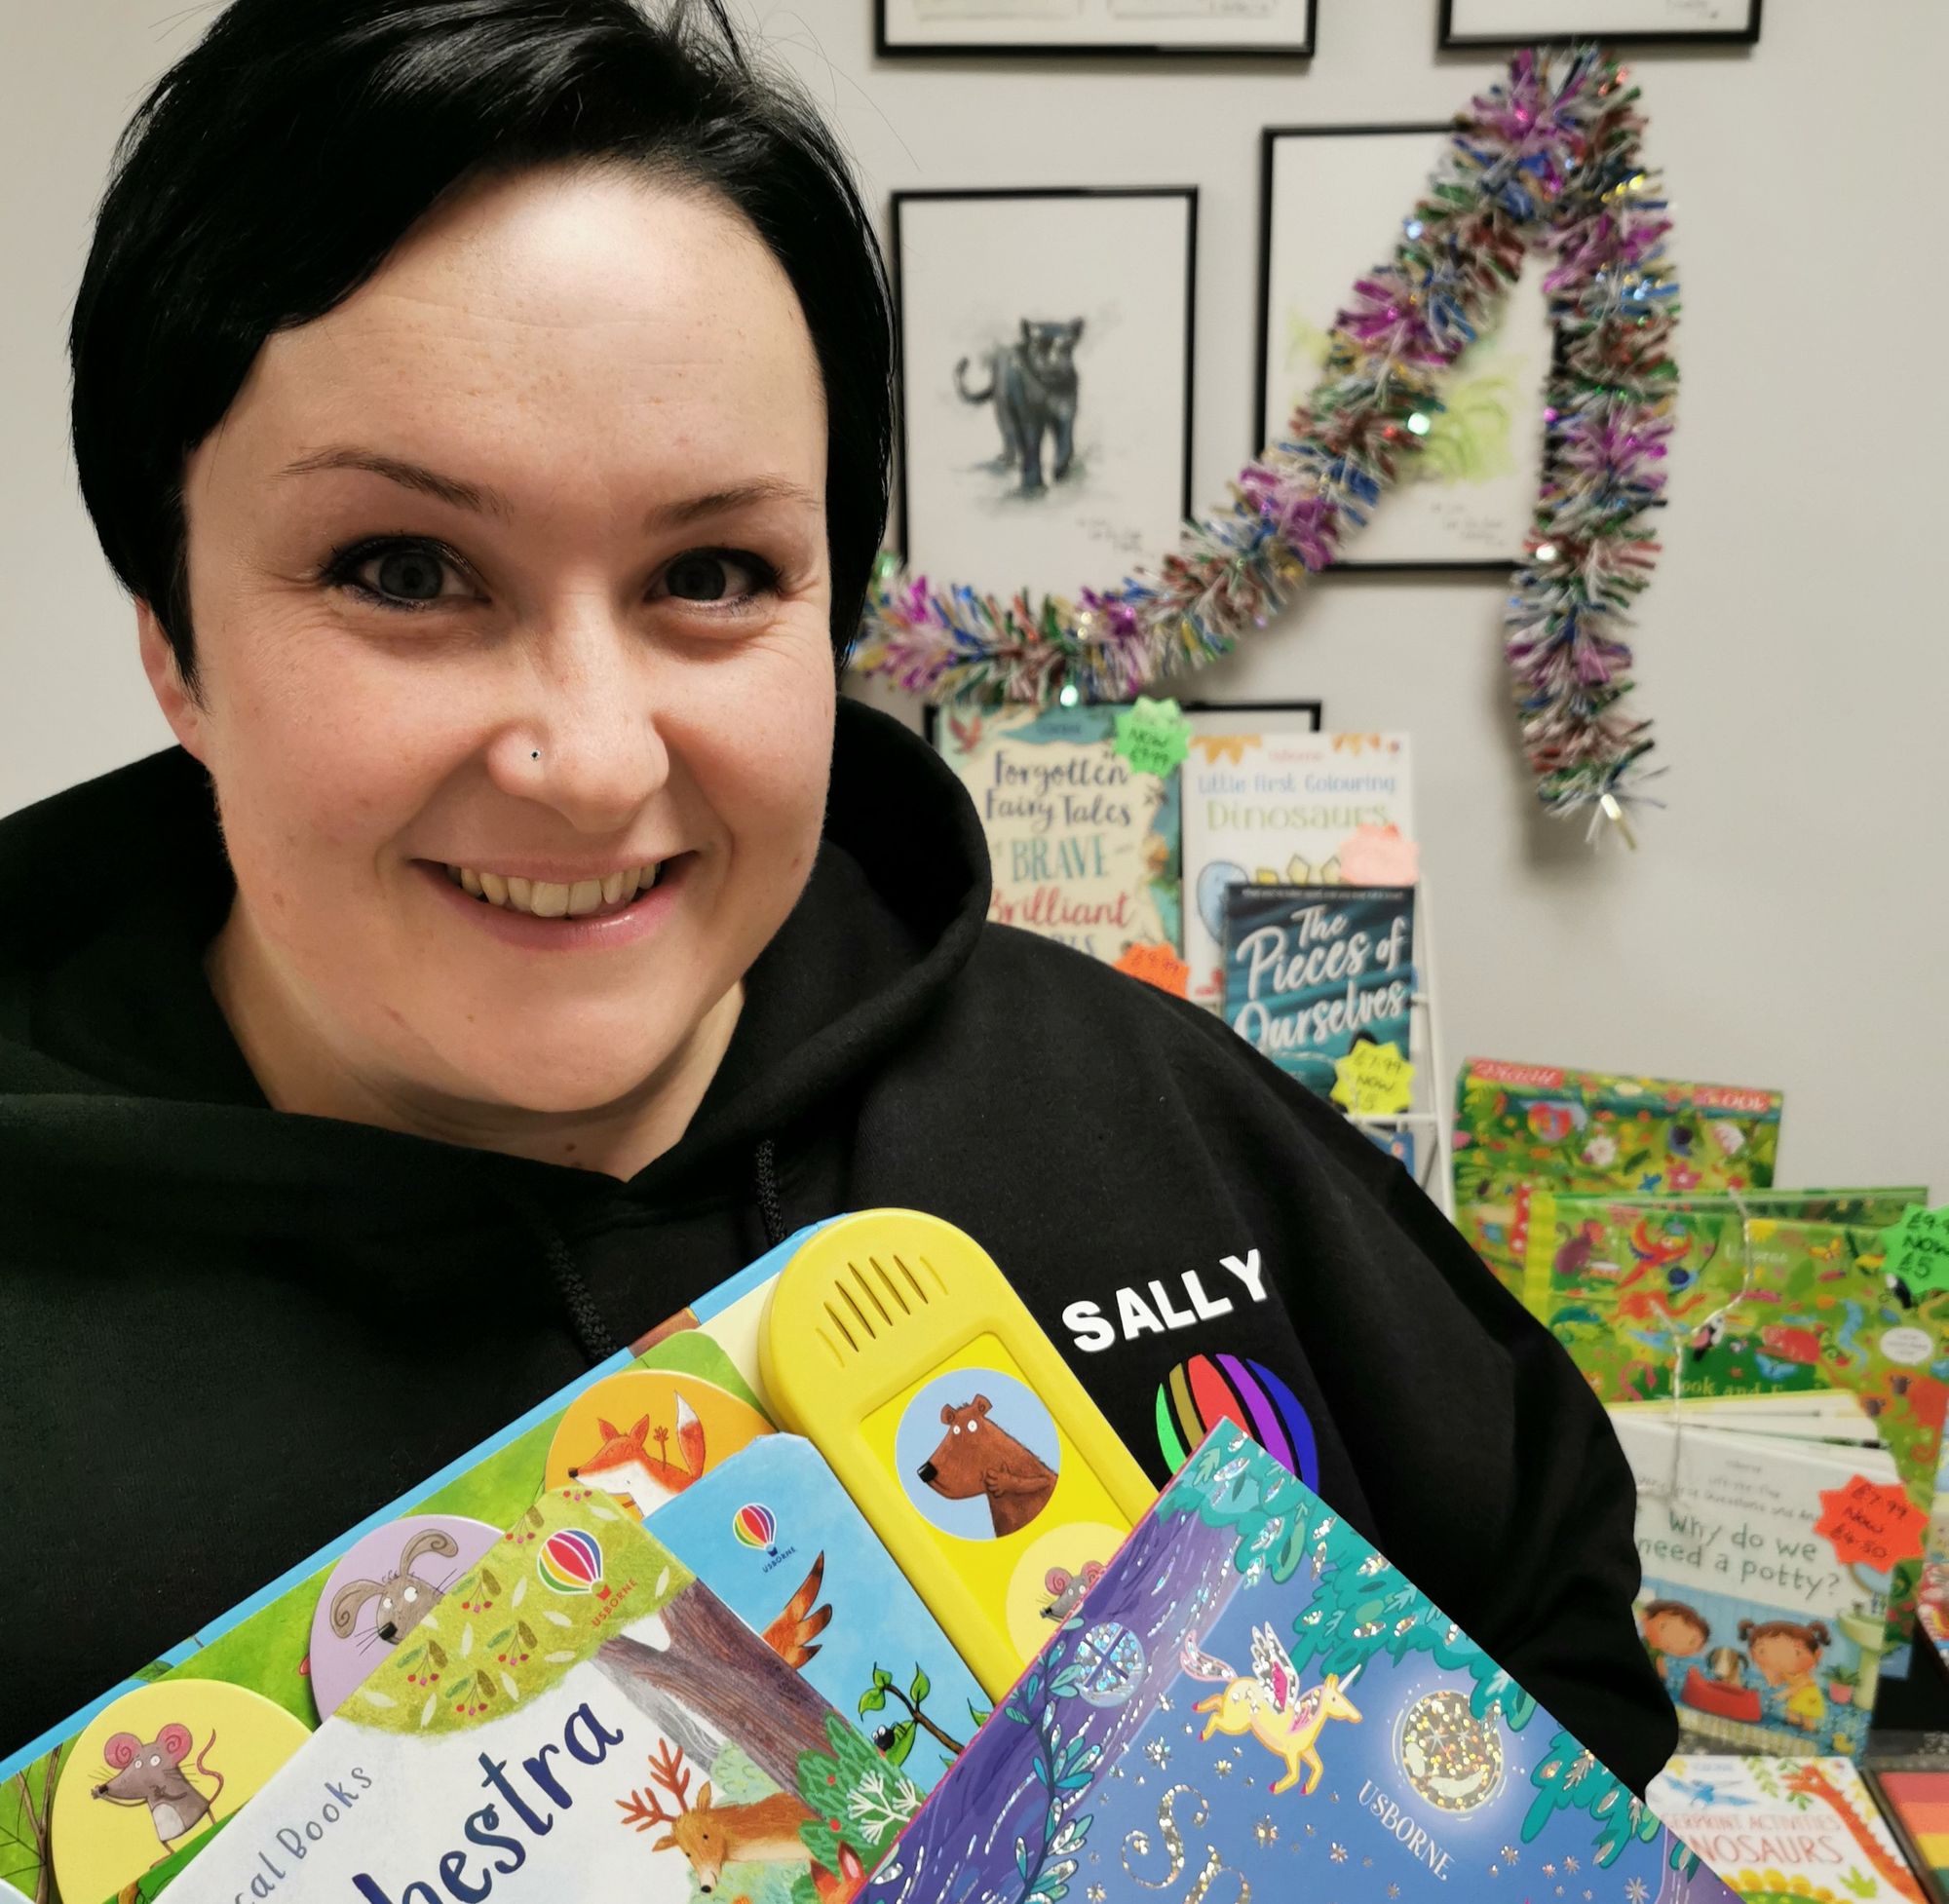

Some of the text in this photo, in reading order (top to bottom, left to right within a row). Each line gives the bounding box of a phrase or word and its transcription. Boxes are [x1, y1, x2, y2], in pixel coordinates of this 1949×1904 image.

[995, 750, 1128, 796] Forgotten
[1198, 775, 1245, 795] Little
[1304, 775, 1396, 795] Colouring
[986, 788, 1131, 833] Fairy Tales
[1206, 799, 1389, 831] Dinosaurs
[1012, 833, 1109, 883] BRAVE
[1290, 903, 1350, 950] The
[1236, 914, 1406, 1001] Pieces of
[1234, 979, 1406, 1050] Ourselves
[1062, 1248, 1267, 1352] SALLY
[762, 1545, 797, 1574] USBORNE
[1668, 1508, 1818, 1561] Why do we
[1637, 1536, 1841, 1600] need a potty?
[592, 1578, 638, 1628] USBORNE
[276, 1766, 373, 1860] Books
[1358, 1778, 1456, 1882] USBORNE
